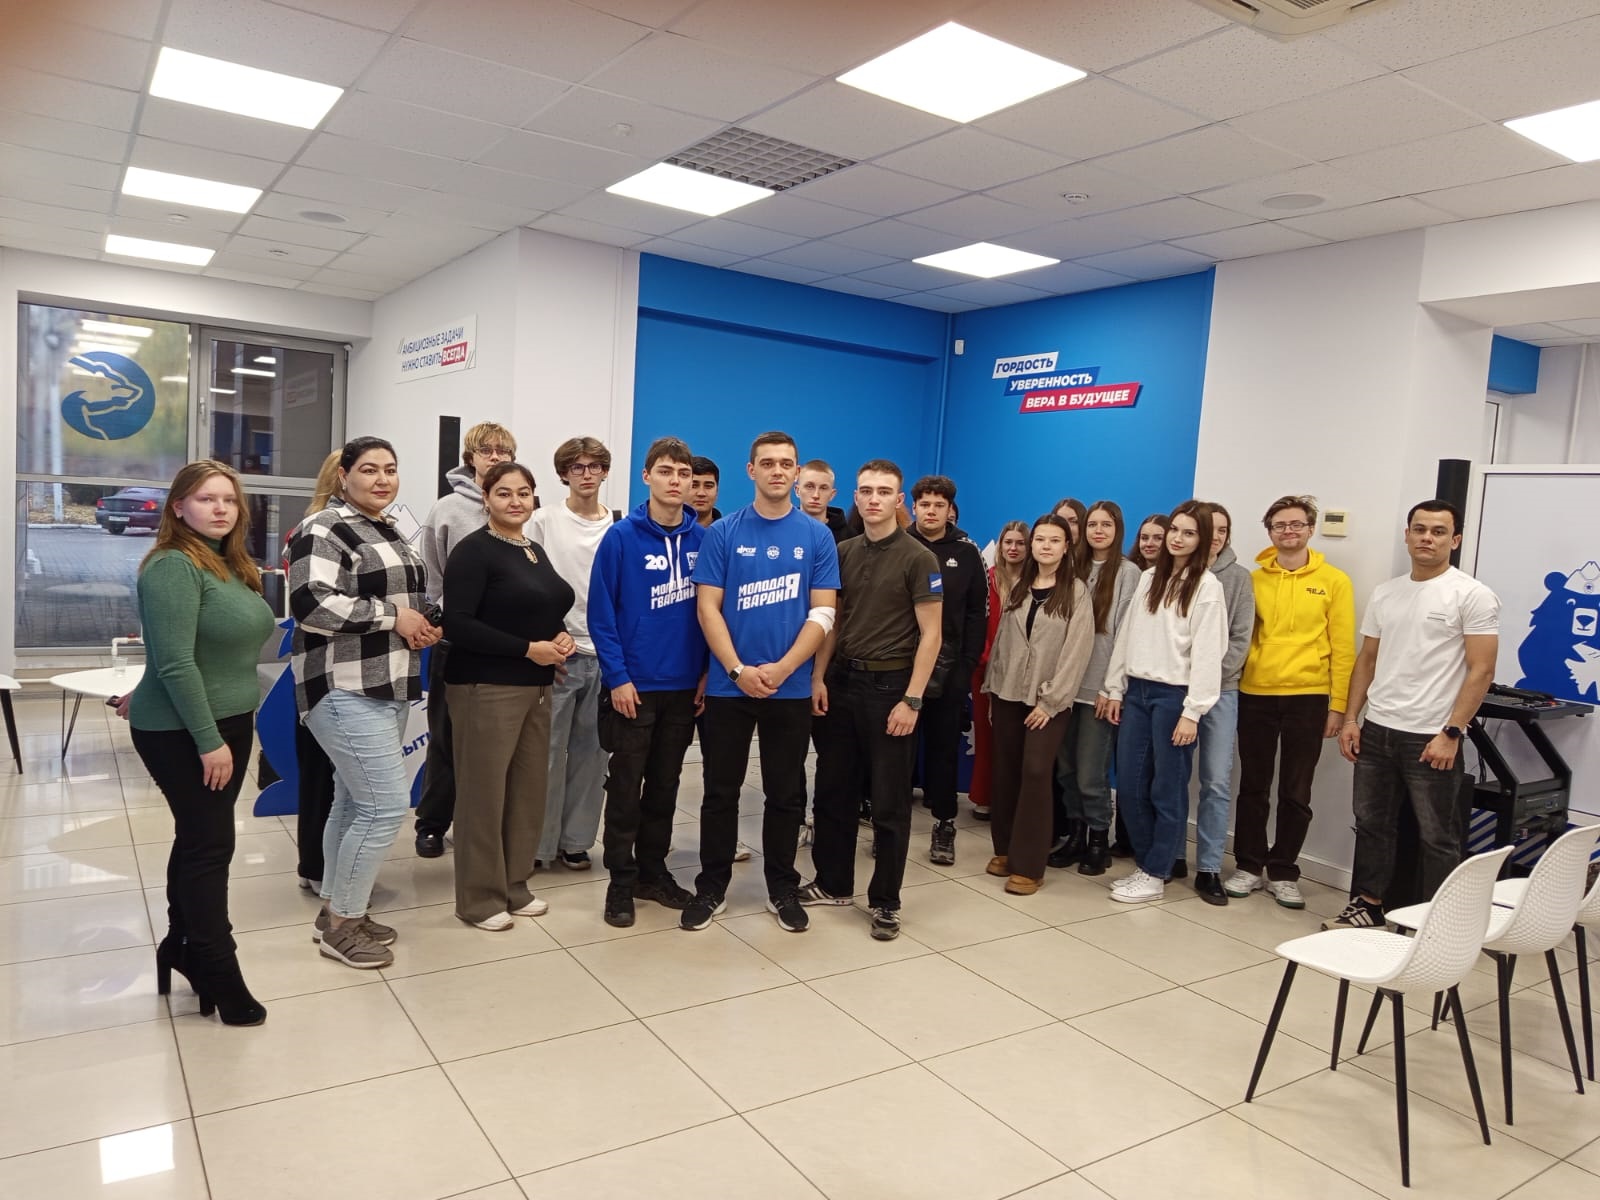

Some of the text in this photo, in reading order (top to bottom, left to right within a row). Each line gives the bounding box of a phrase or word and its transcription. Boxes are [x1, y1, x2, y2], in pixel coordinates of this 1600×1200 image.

[441, 327, 464, 345] ЗАДАЧИ
[402, 345, 465, 371] НУЖНО СТАВИТЬ ВСЕГДА
[996, 357, 1054, 375] ГОРДОСТЬ
[1010, 373, 1093, 391] УВЕРЕННОСТЬ
[1025, 389, 1130, 409] ВЕРА В БУДУЩЕЕ
[644, 554, 668, 570] 20
